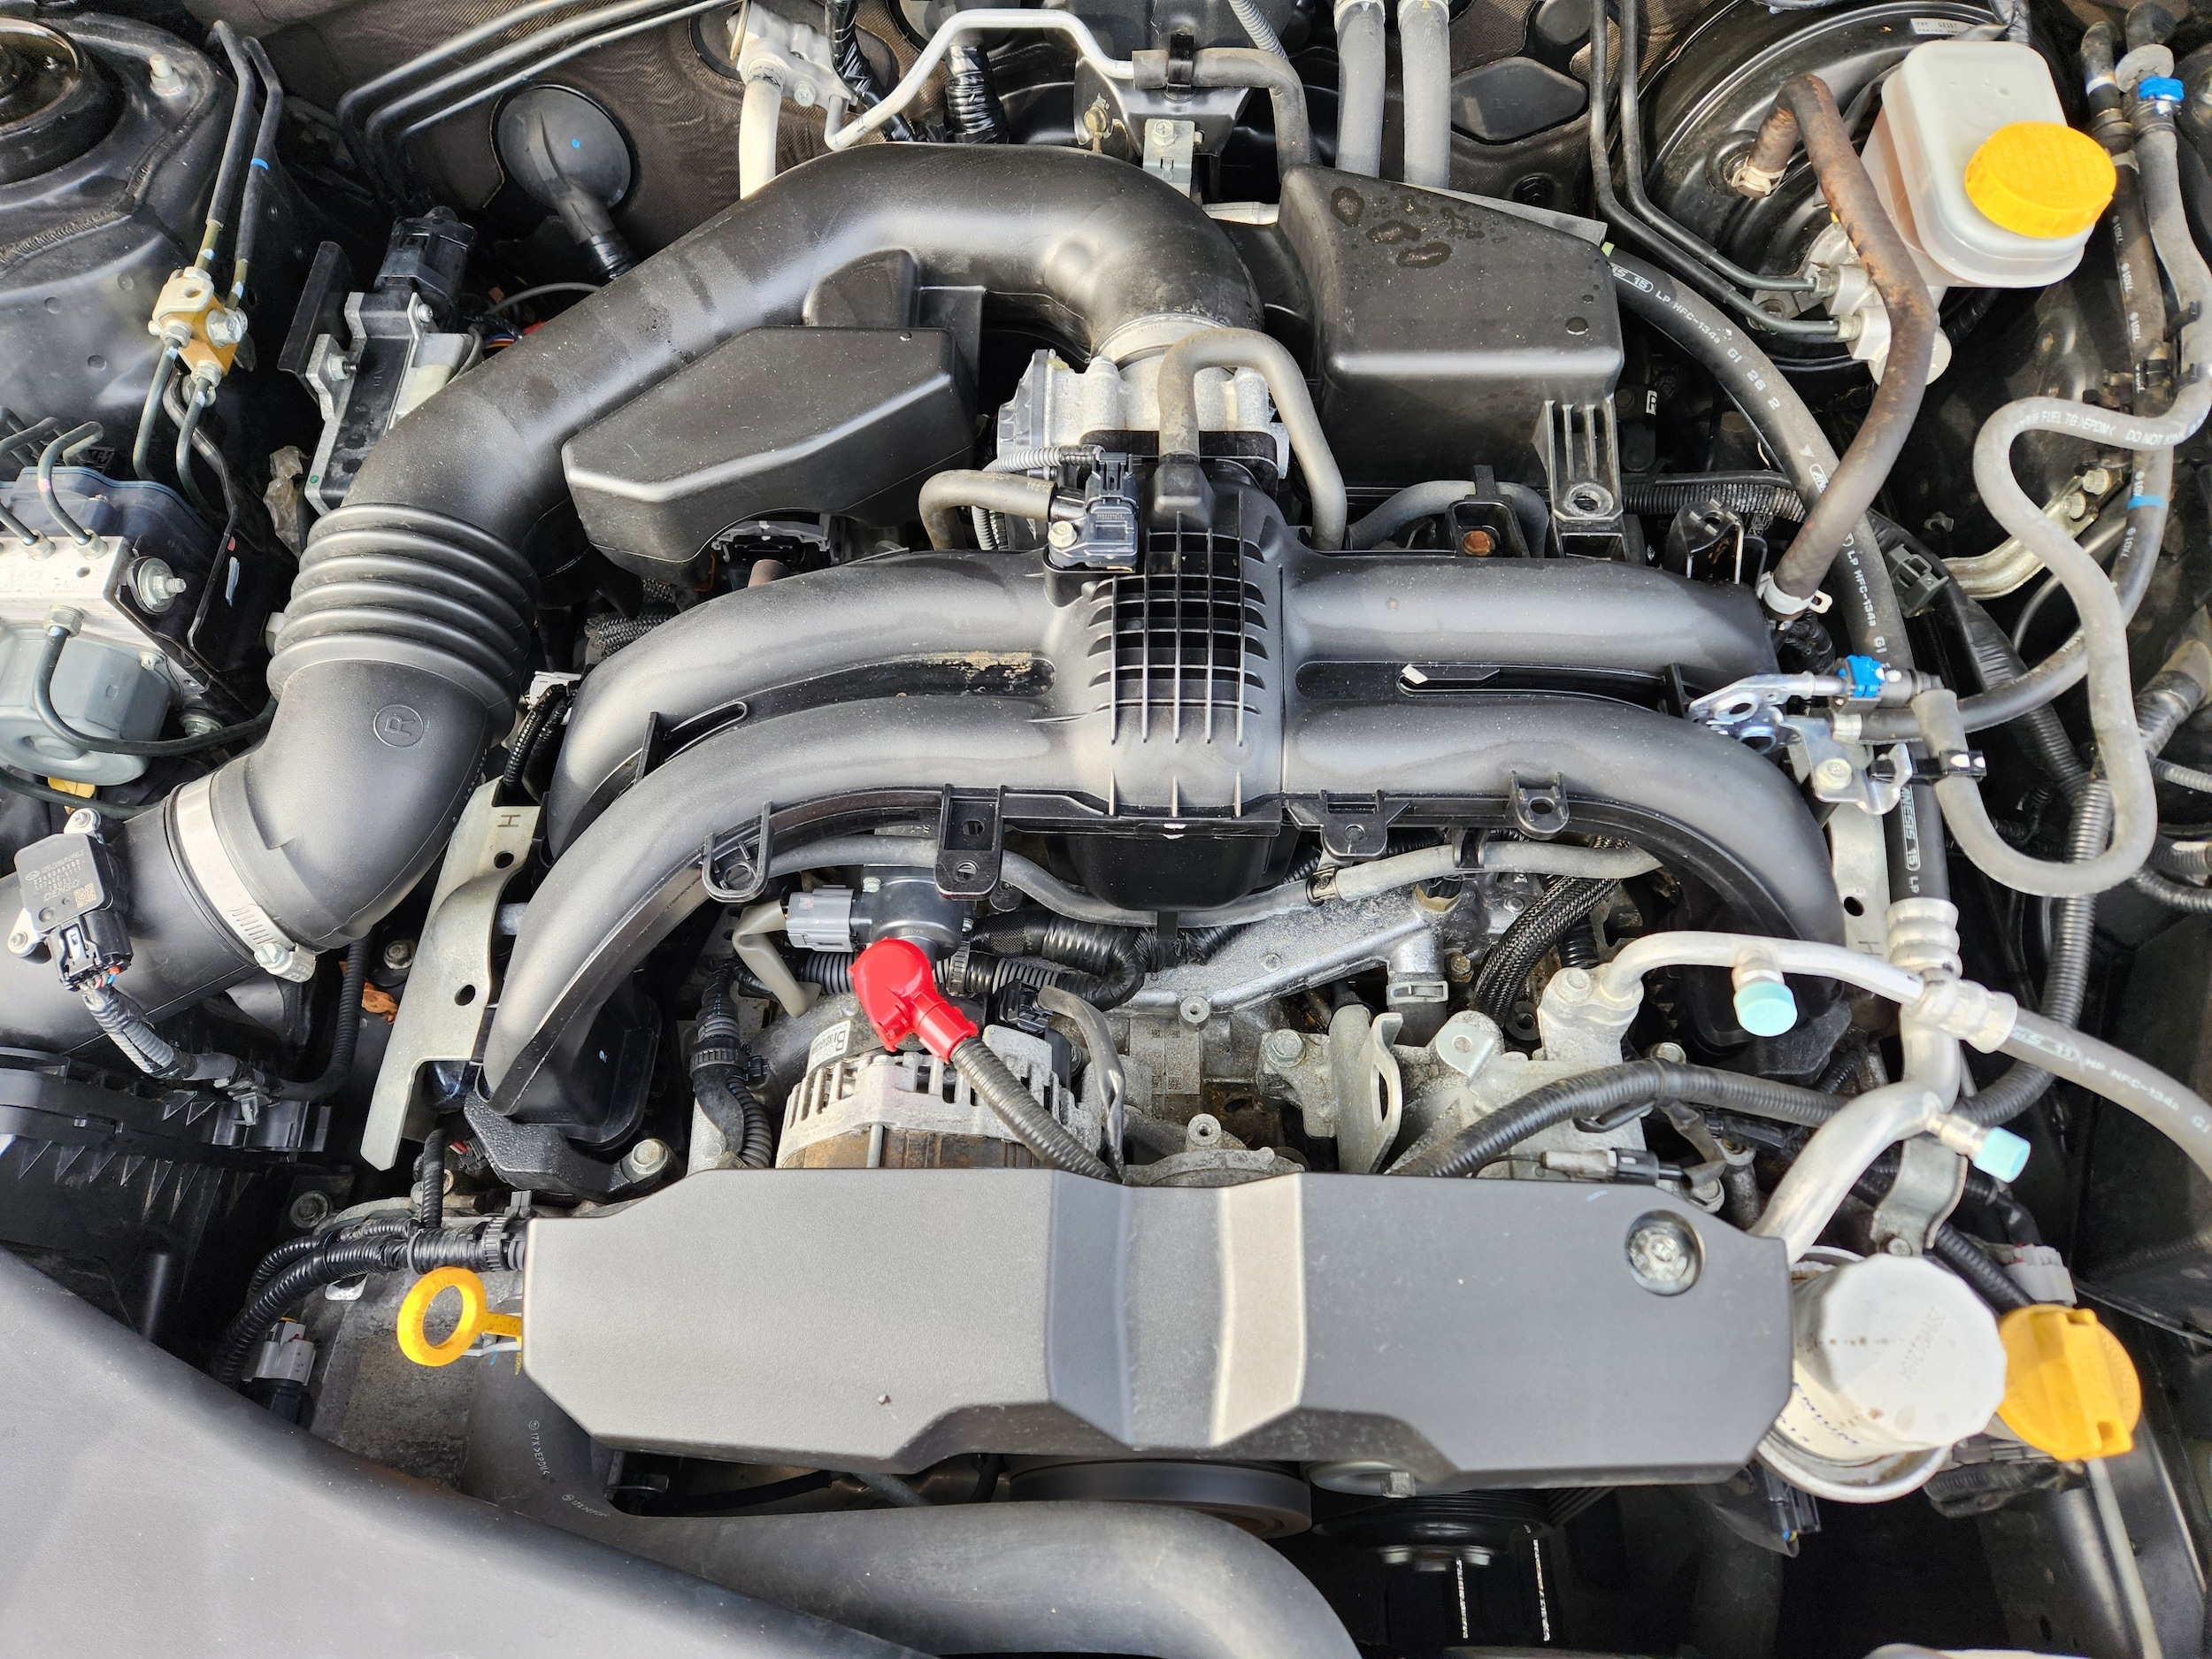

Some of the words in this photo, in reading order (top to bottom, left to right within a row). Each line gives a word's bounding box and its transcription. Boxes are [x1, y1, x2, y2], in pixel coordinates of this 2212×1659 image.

[1634, 275, 1650, 290] 15
[1655, 289, 1671, 303] LP
[1672, 302, 1721, 344] HFC-134a
[1726, 347, 1743, 364] GI
[1746, 369, 1767, 392] 26
[1767, 396, 1782, 411] 2
[2041, 410, 2062, 426] FUEL
[2065, 412, 2079, 427] TG
[2125, 429, 2143, 443] DO
[2142, 433, 2163, 446] NOT
[1847, 549, 1859, 566] LP
[1853, 569, 1878, 627] HFC-134a
[1872, 635, 1888, 655] GI
[1906, 846, 1919, 867] 15
[43, 879, 80, 902] DENSO
[1908, 875, 1920, 894] LP
